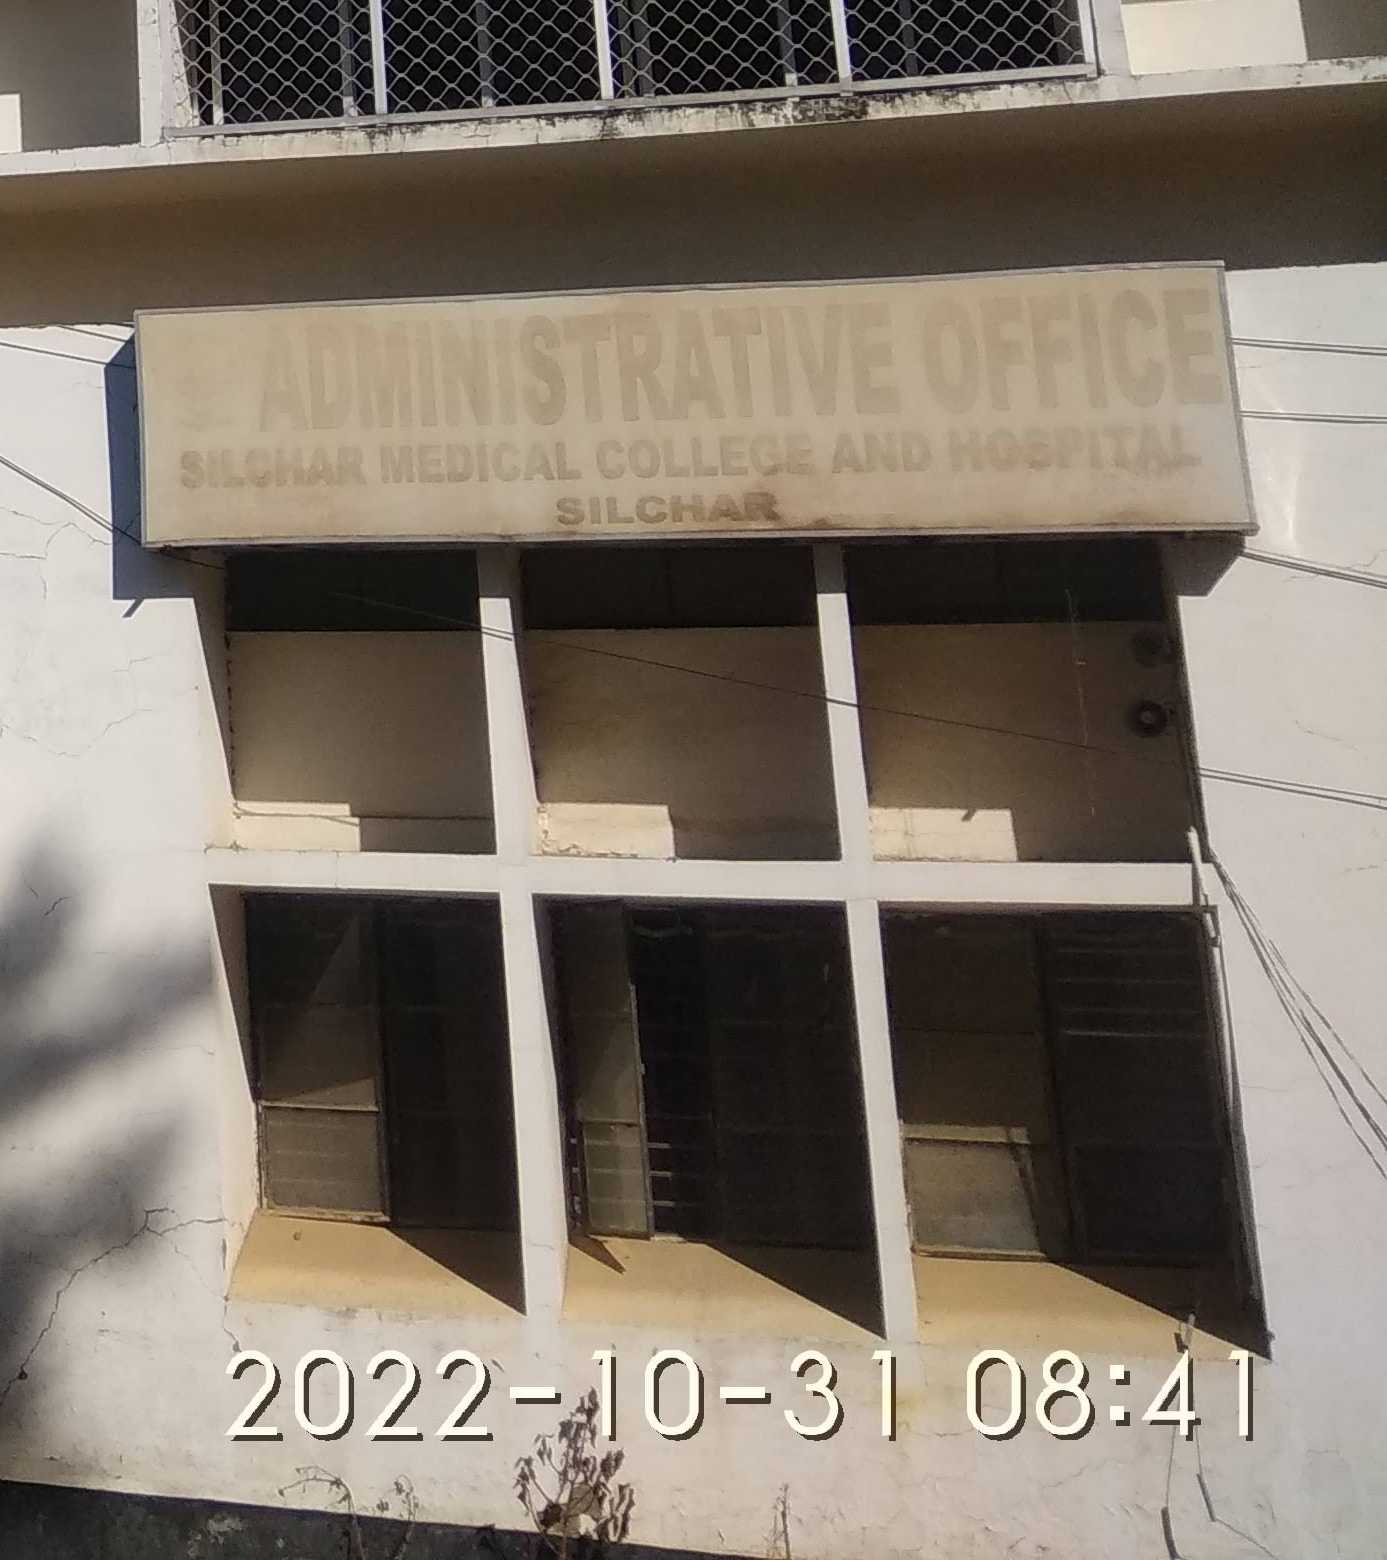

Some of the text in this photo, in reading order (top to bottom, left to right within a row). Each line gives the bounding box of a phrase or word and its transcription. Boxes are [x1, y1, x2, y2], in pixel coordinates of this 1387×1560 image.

[257, 287, 1225, 433] ADMINISTRATIVE OFFICE
[178, 422, 1204, 489] SILCHAR MEDICAL COLLEGE AND HOSPITAL
[554, 491, 782, 527] SILCHAR
